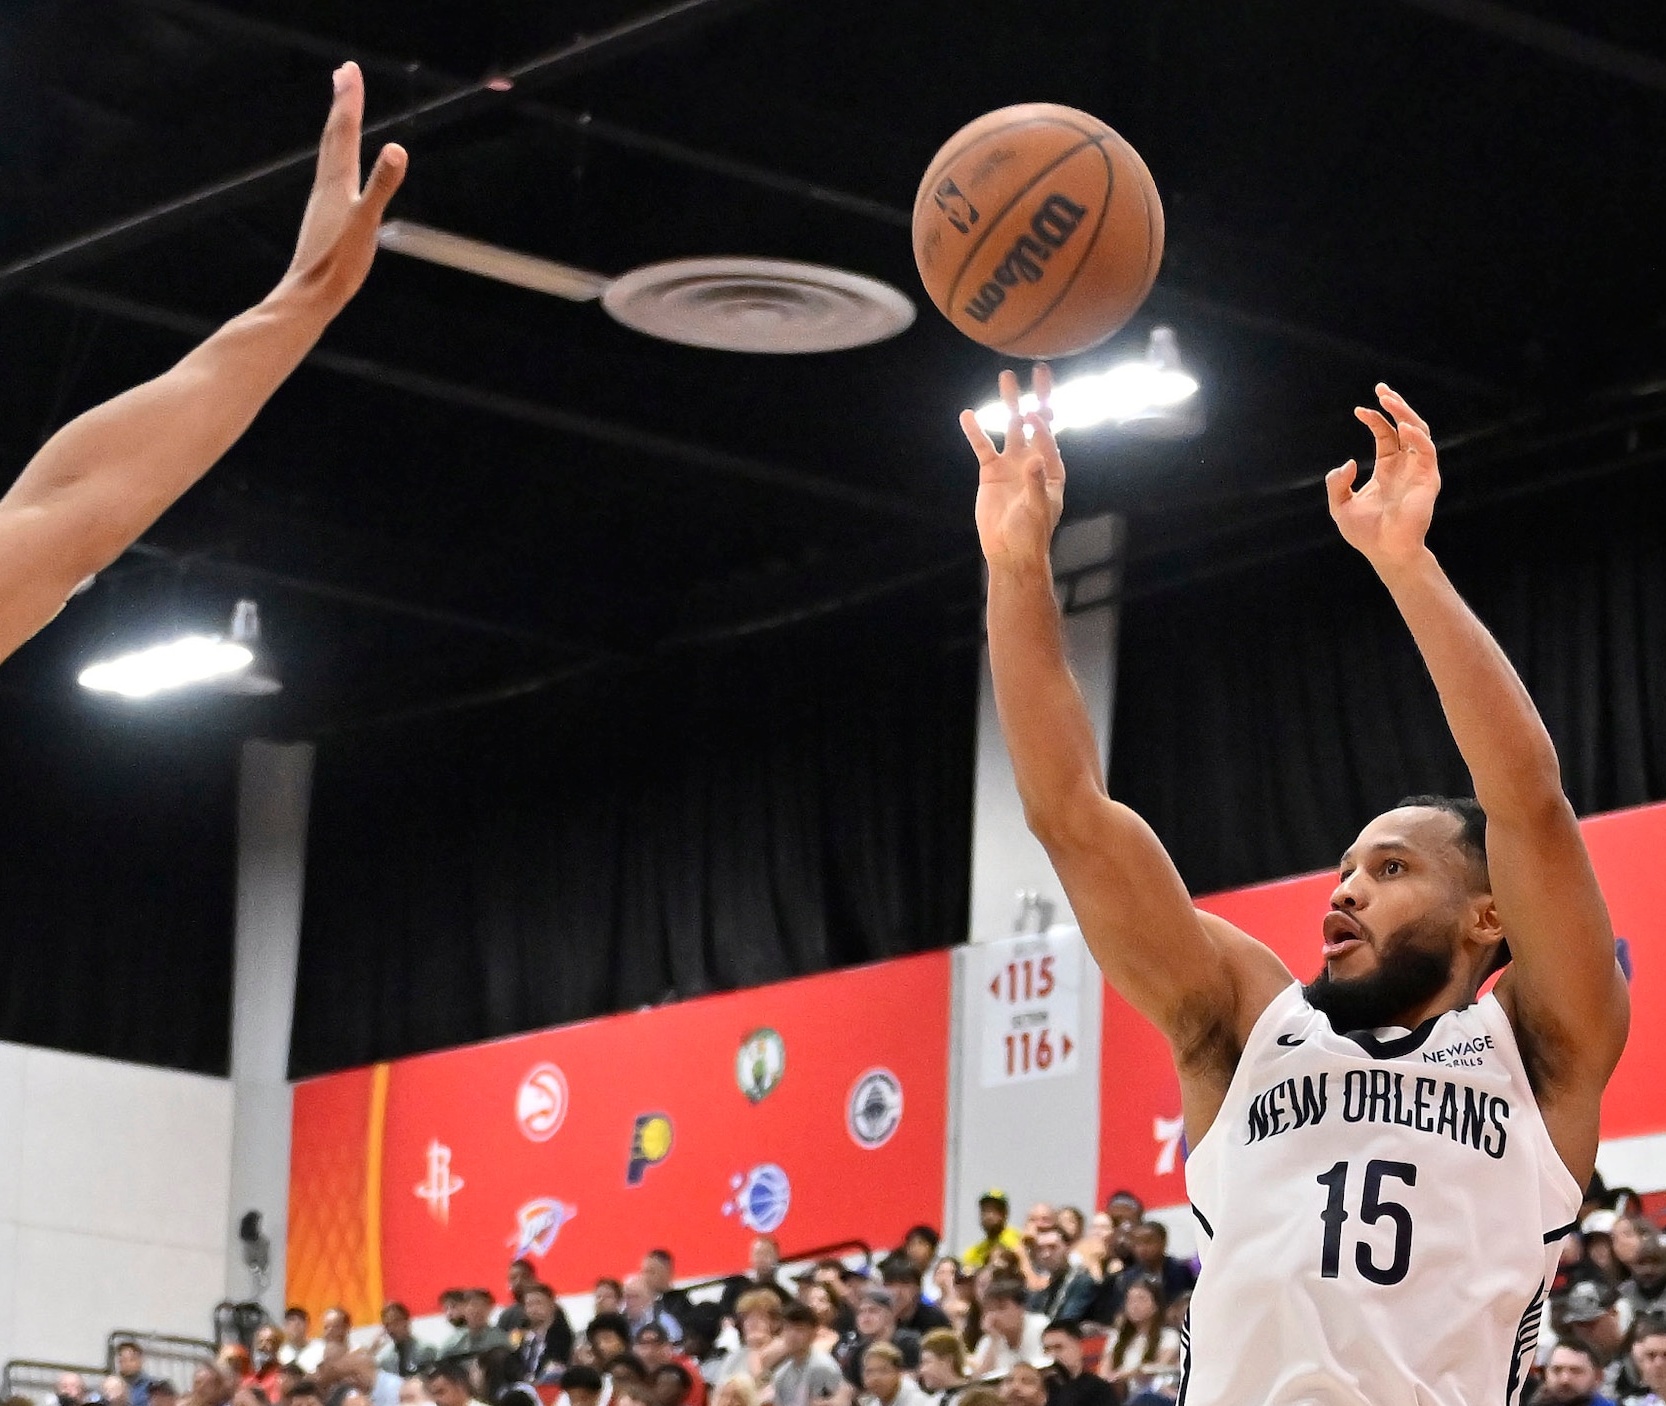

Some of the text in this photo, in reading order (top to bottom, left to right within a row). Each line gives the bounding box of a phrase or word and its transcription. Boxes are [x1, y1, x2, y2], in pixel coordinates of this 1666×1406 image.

[965, 193, 1087, 323] Wilson
[1007, 955, 1056, 1004] 115
[1005, 1028, 1054, 1078] 116
[1422, 1035, 1495, 1063] NEWAGE
[1244, 1069, 1511, 1159] NEW ORLEANS
[1316, 1159, 1417, 1286] 15
